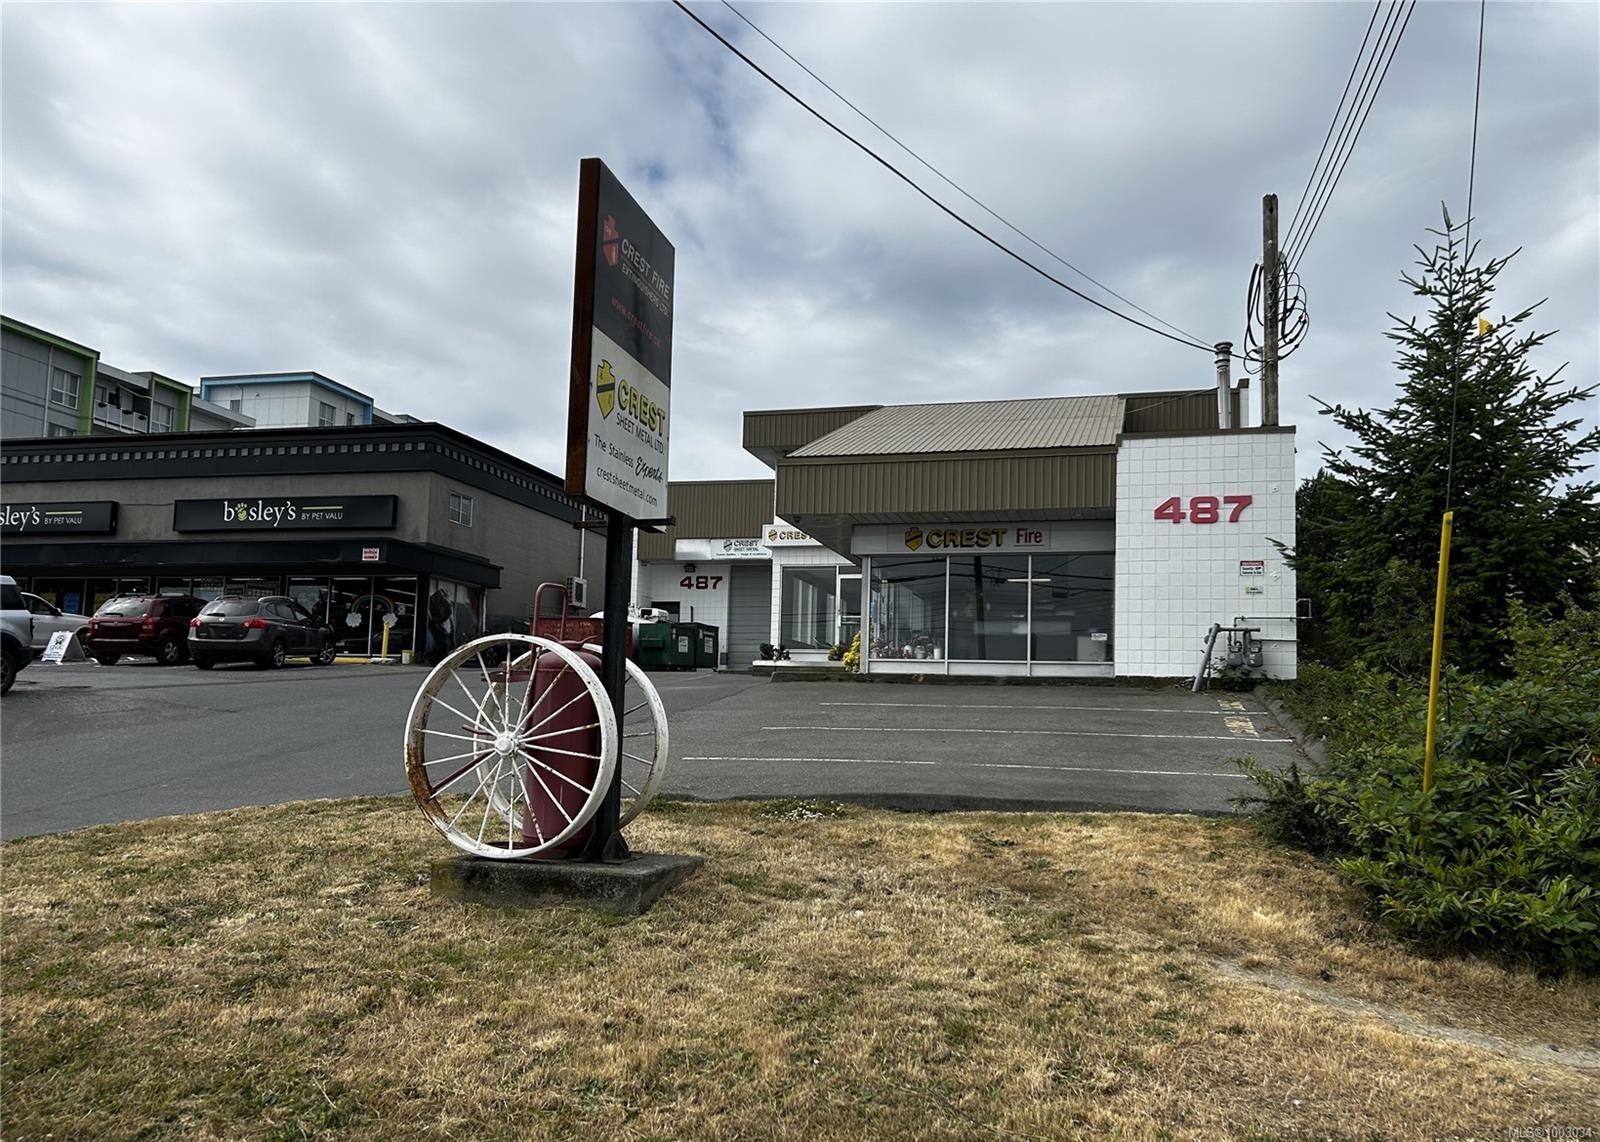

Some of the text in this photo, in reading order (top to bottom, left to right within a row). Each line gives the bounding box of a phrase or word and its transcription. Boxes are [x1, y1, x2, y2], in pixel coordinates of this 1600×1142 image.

[621, 238, 670, 300] CREST FIRE
[617, 379, 667, 437] CREST
[616, 412, 665, 456] SHEET METAL LTD.
[594, 433, 664, 484] The Stainless Experts
[596, 466, 658, 507] crestsheetmetal.com
[53, 517, 65, 525] PET
[324, 512, 343, 520] VALU
[1154, 495, 1254, 524] 487
[733, 539, 760, 547] CREST
[779, 531, 812, 540] CRES
[926, 527, 1043, 548] CREST Fire
[679, 576, 723, 590] 487
